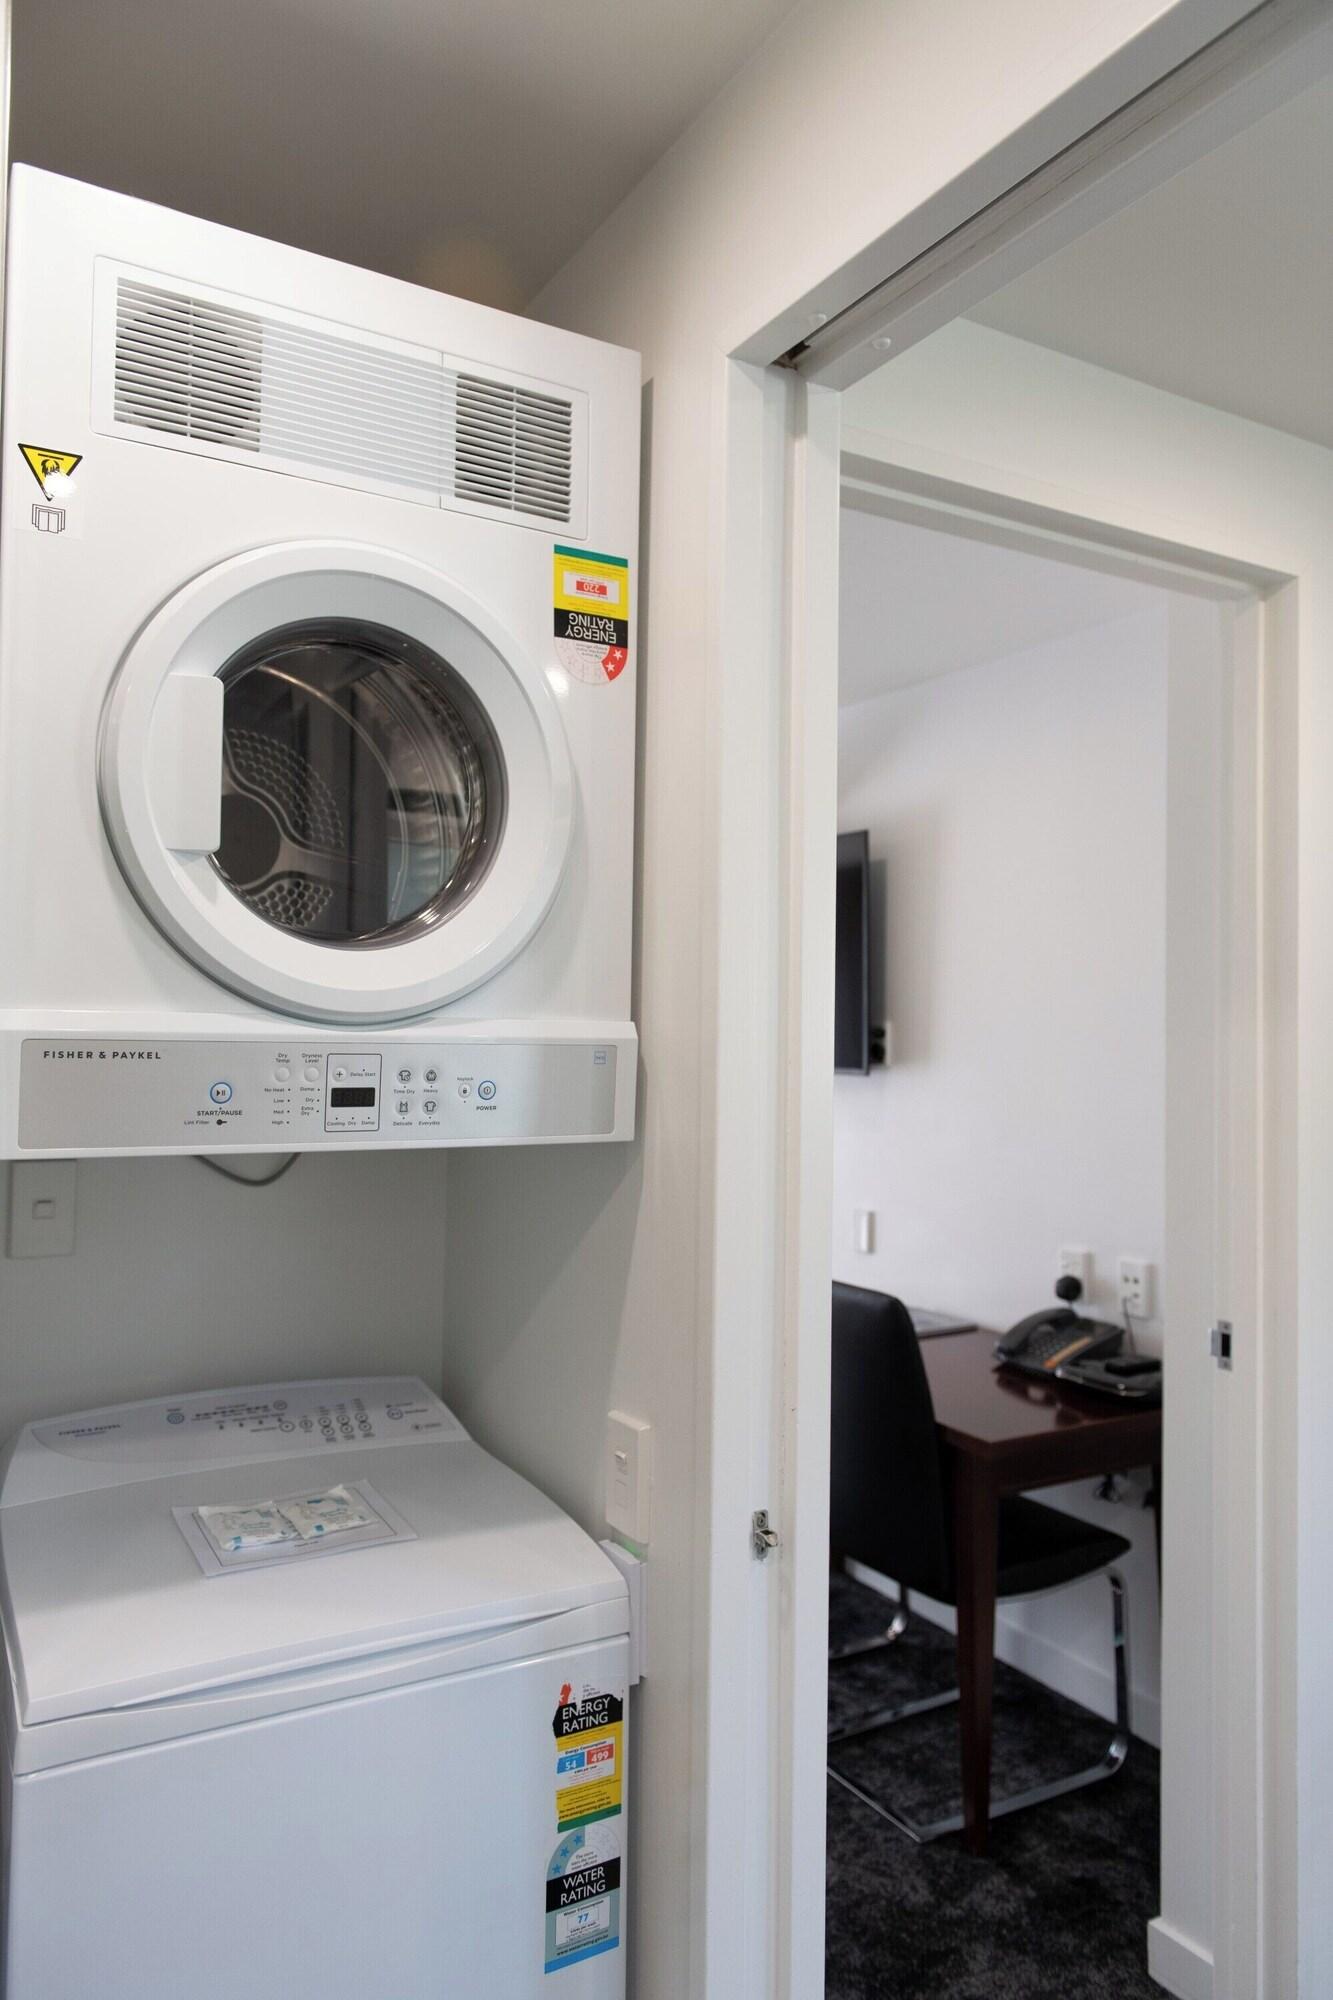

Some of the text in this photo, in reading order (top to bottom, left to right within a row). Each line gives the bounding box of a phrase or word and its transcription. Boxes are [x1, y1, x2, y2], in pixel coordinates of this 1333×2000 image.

[583, 582, 600, 594] 220
[568, 612, 614, 632] RATING
[564, 625, 616, 644] ENERGY
[44, 1050, 162, 1060] FISHER & PAYKEL
[562, 1696, 610, 1720] ENERGY
[563, 1711, 608, 1734] RATING
[565, 1760, 577, 1770] 54
[592, 1751, 609, 1762] 499
[562, 1866, 605, 1889] WATER
[560, 1880, 606, 1906] RATING
[578, 1912, 589, 1924] 77
